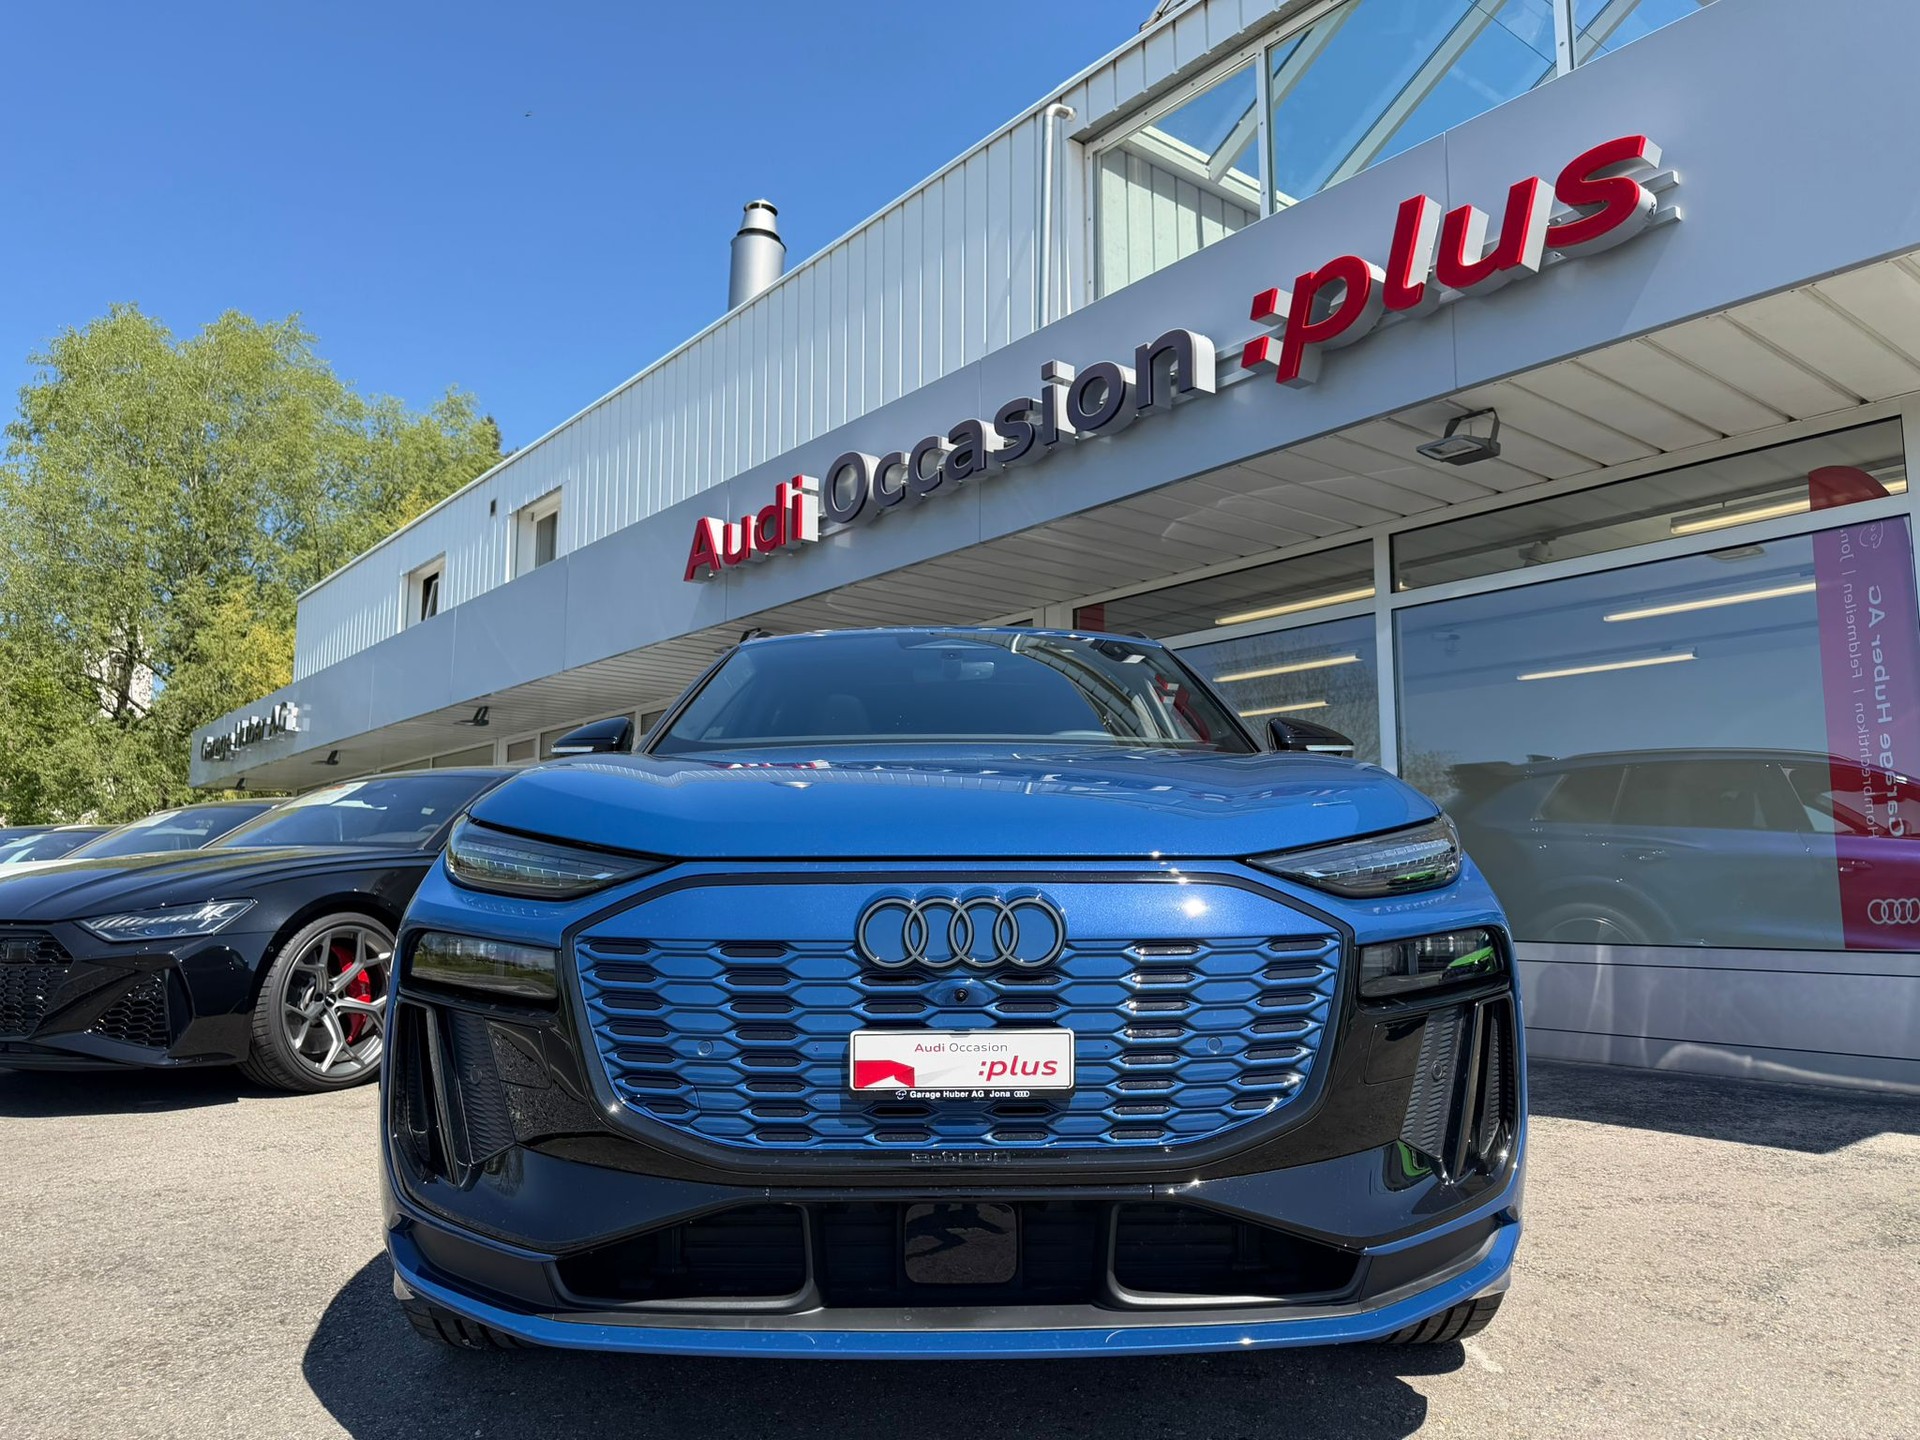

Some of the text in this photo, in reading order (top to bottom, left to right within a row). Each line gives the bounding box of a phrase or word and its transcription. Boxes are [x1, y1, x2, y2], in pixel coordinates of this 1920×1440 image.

[683, 473, 819, 583] Audi
[823, 327, 1216, 525] Occasion
[914, 1042, 1008, 1053] Audi Occasion
[909, 1089, 1011, 1099] Garage Huber AG Jona
